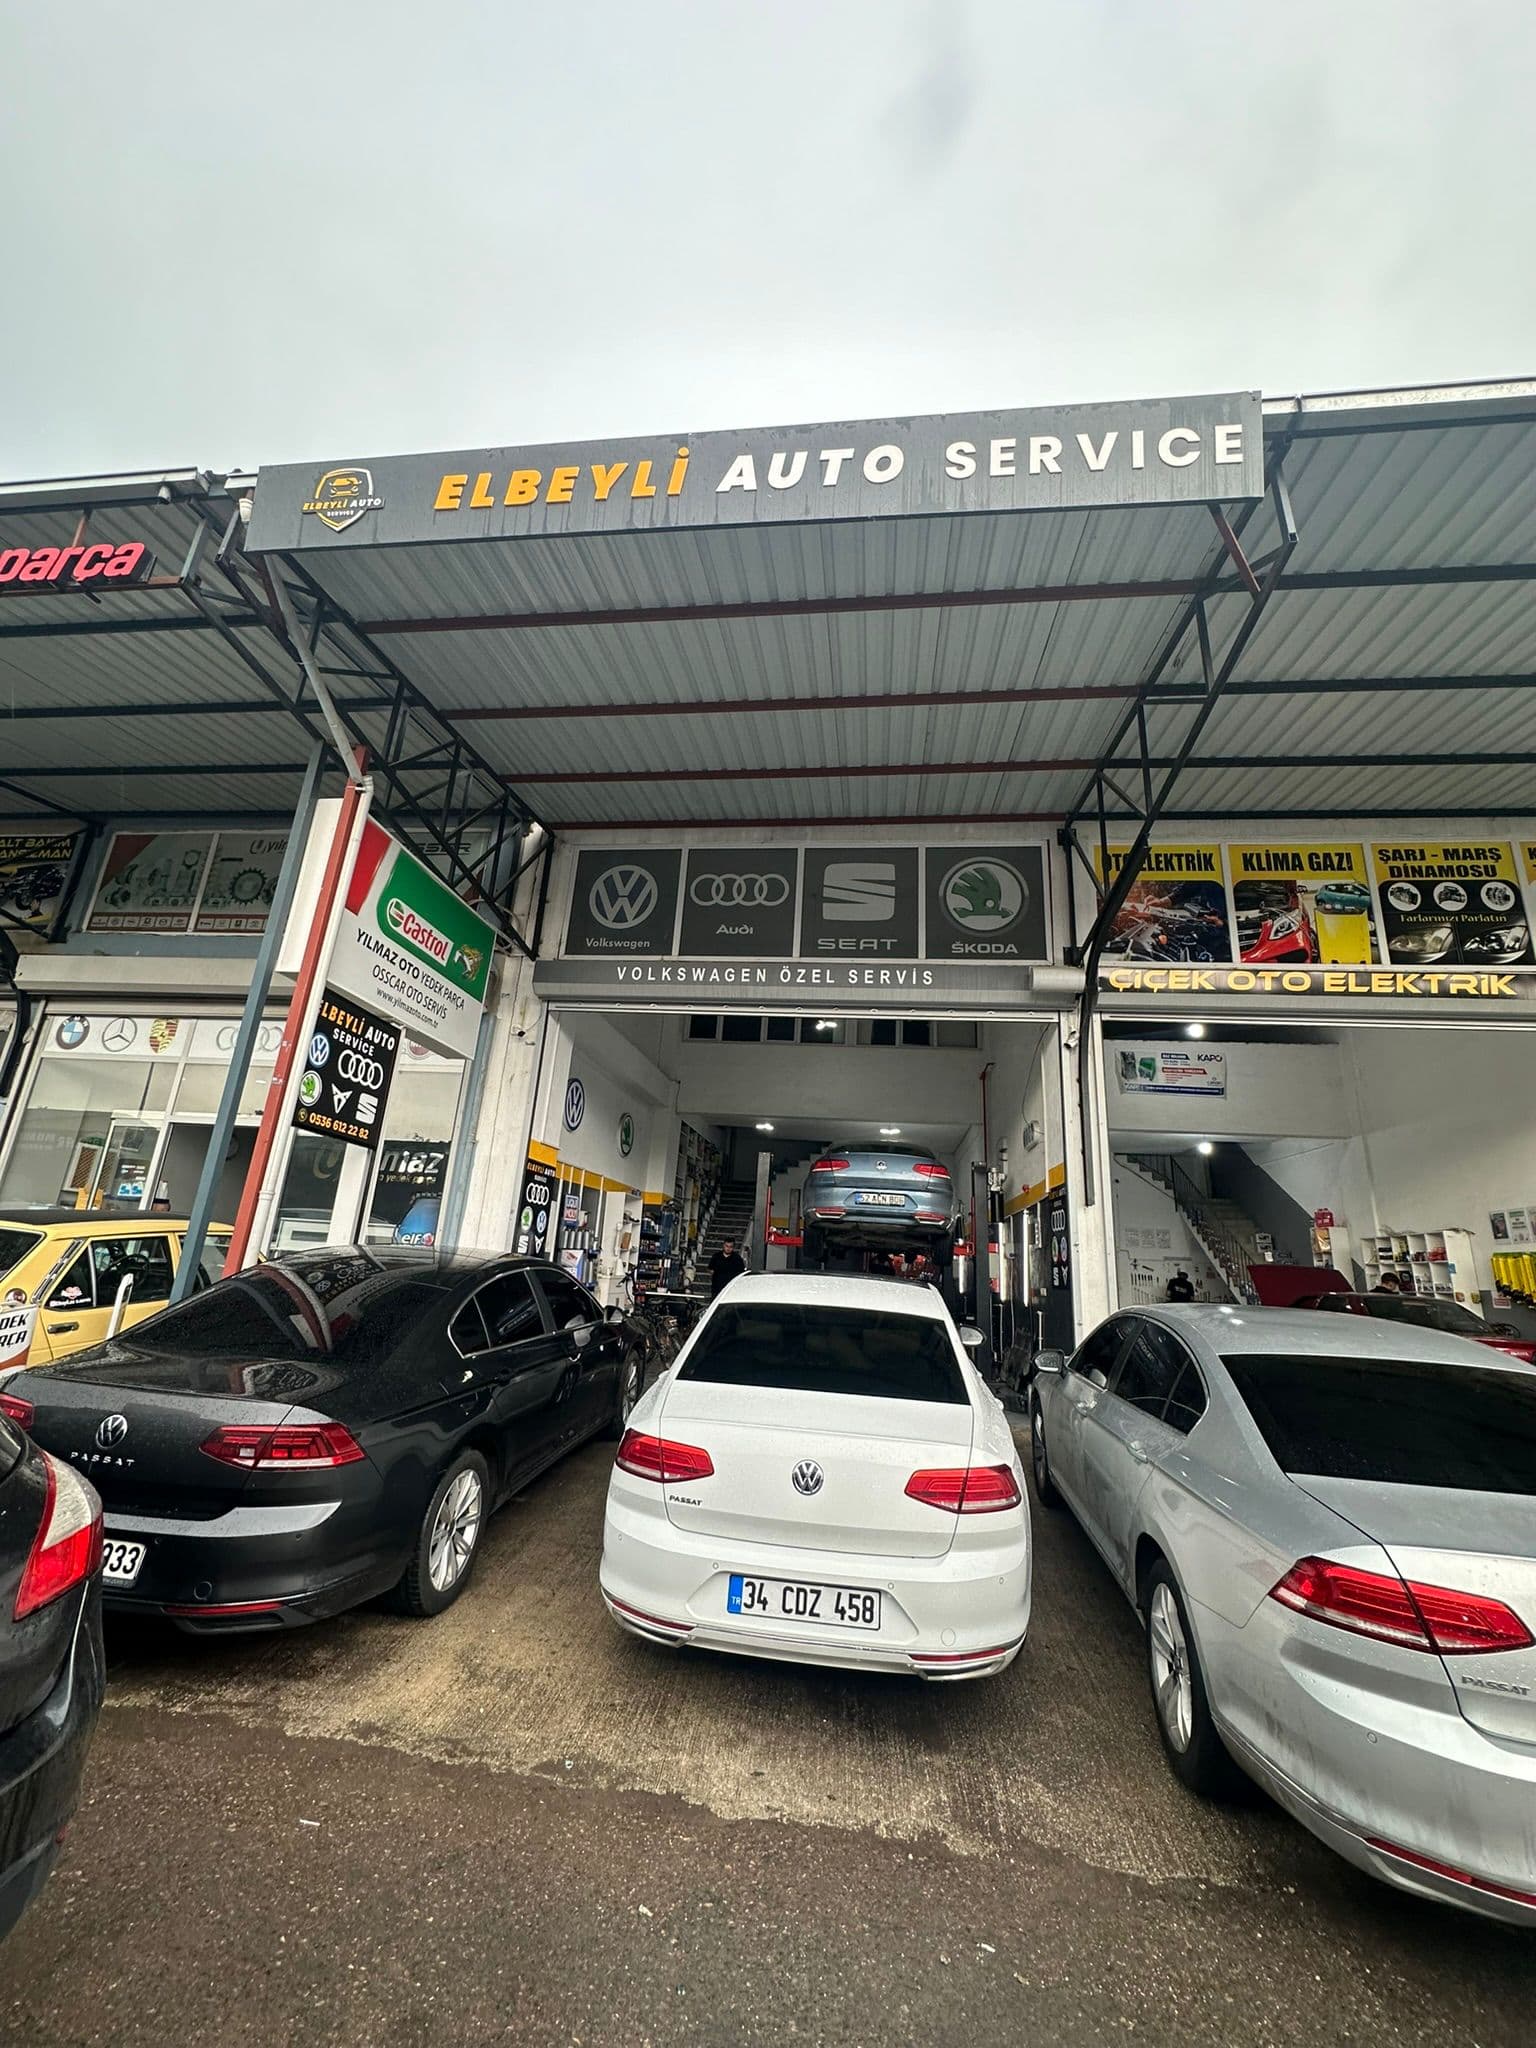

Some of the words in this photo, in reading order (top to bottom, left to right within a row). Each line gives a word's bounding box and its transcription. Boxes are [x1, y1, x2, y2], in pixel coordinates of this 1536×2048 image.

[433, 447, 690, 511] ELBEYLİ
[715, 444, 905, 493] AUTO
[945, 423, 1245, 480] SERVICE
[350, 498, 382, 508] AUTO
[1242, 849, 1304, 872] KLİMA
[1442, 847, 1502, 863] MARŞ
[1388, 863, 1498, 878] DİNAMOSU
[402, 913, 450, 961] Castrol
[716, 924, 753, 935] Audi
[585, 938, 650, 950] Volkswagen
[817, 938, 898, 951] SEAT
[951, 940, 1019, 955] ŠKODA
[356, 928, 399, 966] YILMAZ
[398, 958, 420, 979] OTO
[421, 971, 444, 994] YEDEK
[442, 987, 465, 1011] PARÇA
[617, 966, 767, 982] VOLKSWAGEN
[779, 965, 835, 984] ÖZEL
[848, 967, 934, 986] SERVİS
[372, 964, 407, 994] OSSCAR
[406, 985, 423, 1005] OTO
[422, 996, 448, 1019] SERVİS
[1227, 970, 1311, 992] OTO
[319, 999, 366, 1035] LBEYLİ
[364, 1025, 395, 1051] AUTO
[309, 1112, 332, 1129] 0536
[332, 1120, 347, 1134] 612
[347, 1124, 359, 1137] 22
[401, 1233, 422, 1245] elf
[70, 1451, 135, 1467] PASSAT
[669, 1494, 703, 1506] PASSAT
[731, 1596, 741, 1606] TR
[743, 1581, 768, 1611] 34
[782, 1585, 822, 1618] CDZ
[834, 1591, 875, 1624] 458
[1461, 1674, 1531, 1696] PASSAT
